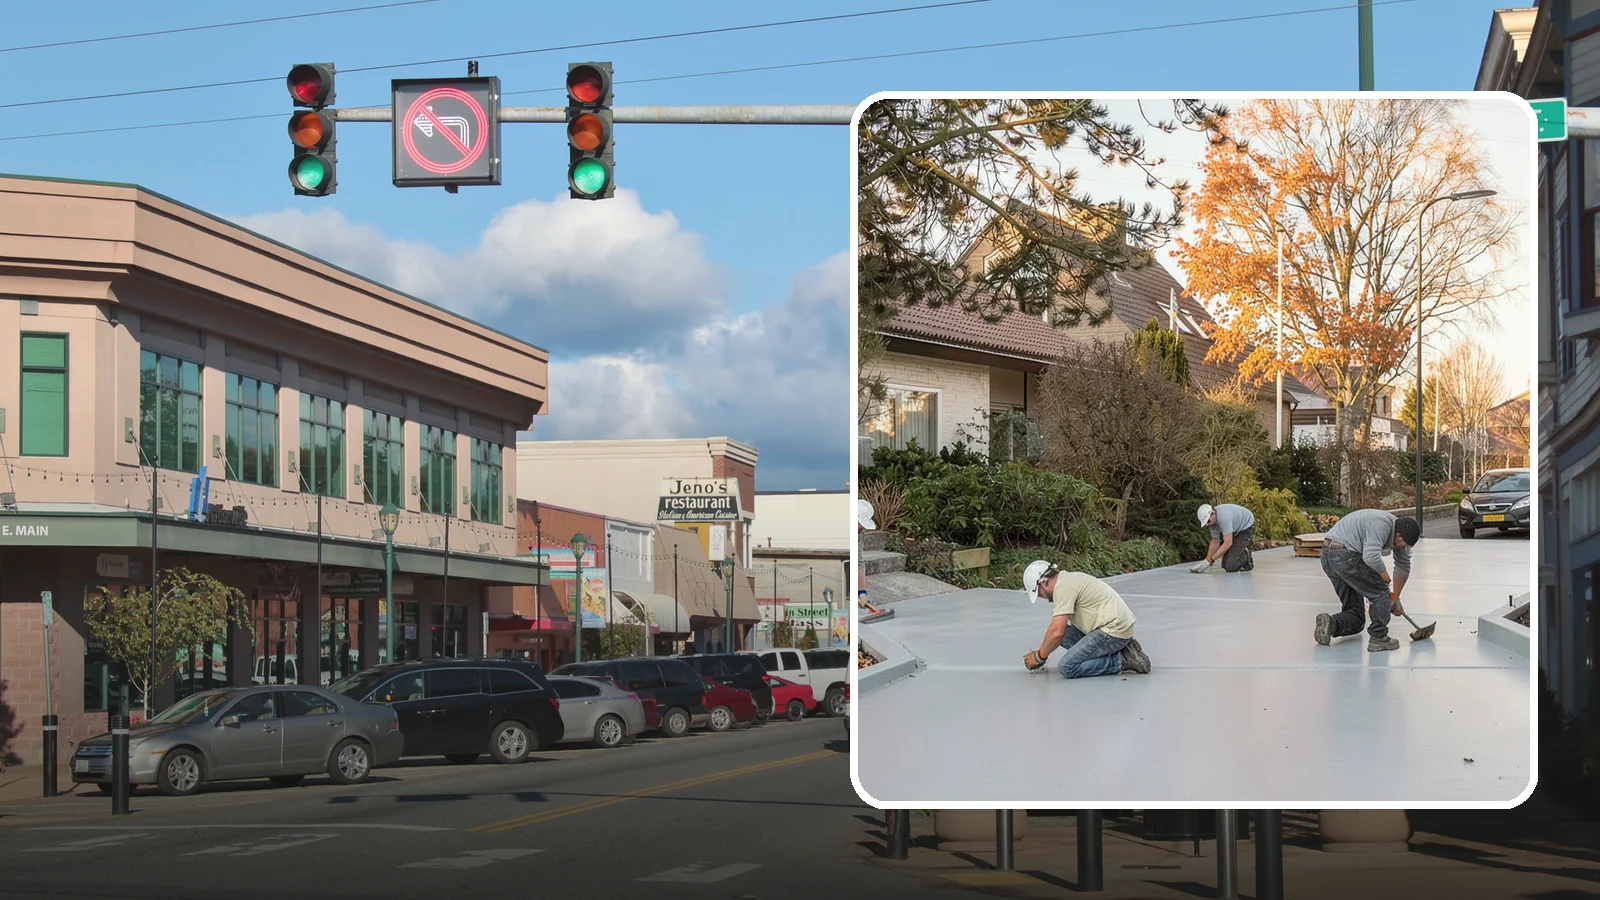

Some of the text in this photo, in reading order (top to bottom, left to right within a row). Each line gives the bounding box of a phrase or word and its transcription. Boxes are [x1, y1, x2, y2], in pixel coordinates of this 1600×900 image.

[670, 480, 727, 494] Jeno's
[665, 496, 730, 508] restaurant
[658, 510, 681, 519] Italian
[686, 510, 714, 519] American
[715, 510, 737, 519] Cuisine
[2, 525, 48, 536] E. MAIN
[786, 608, 828, 616] in Street
